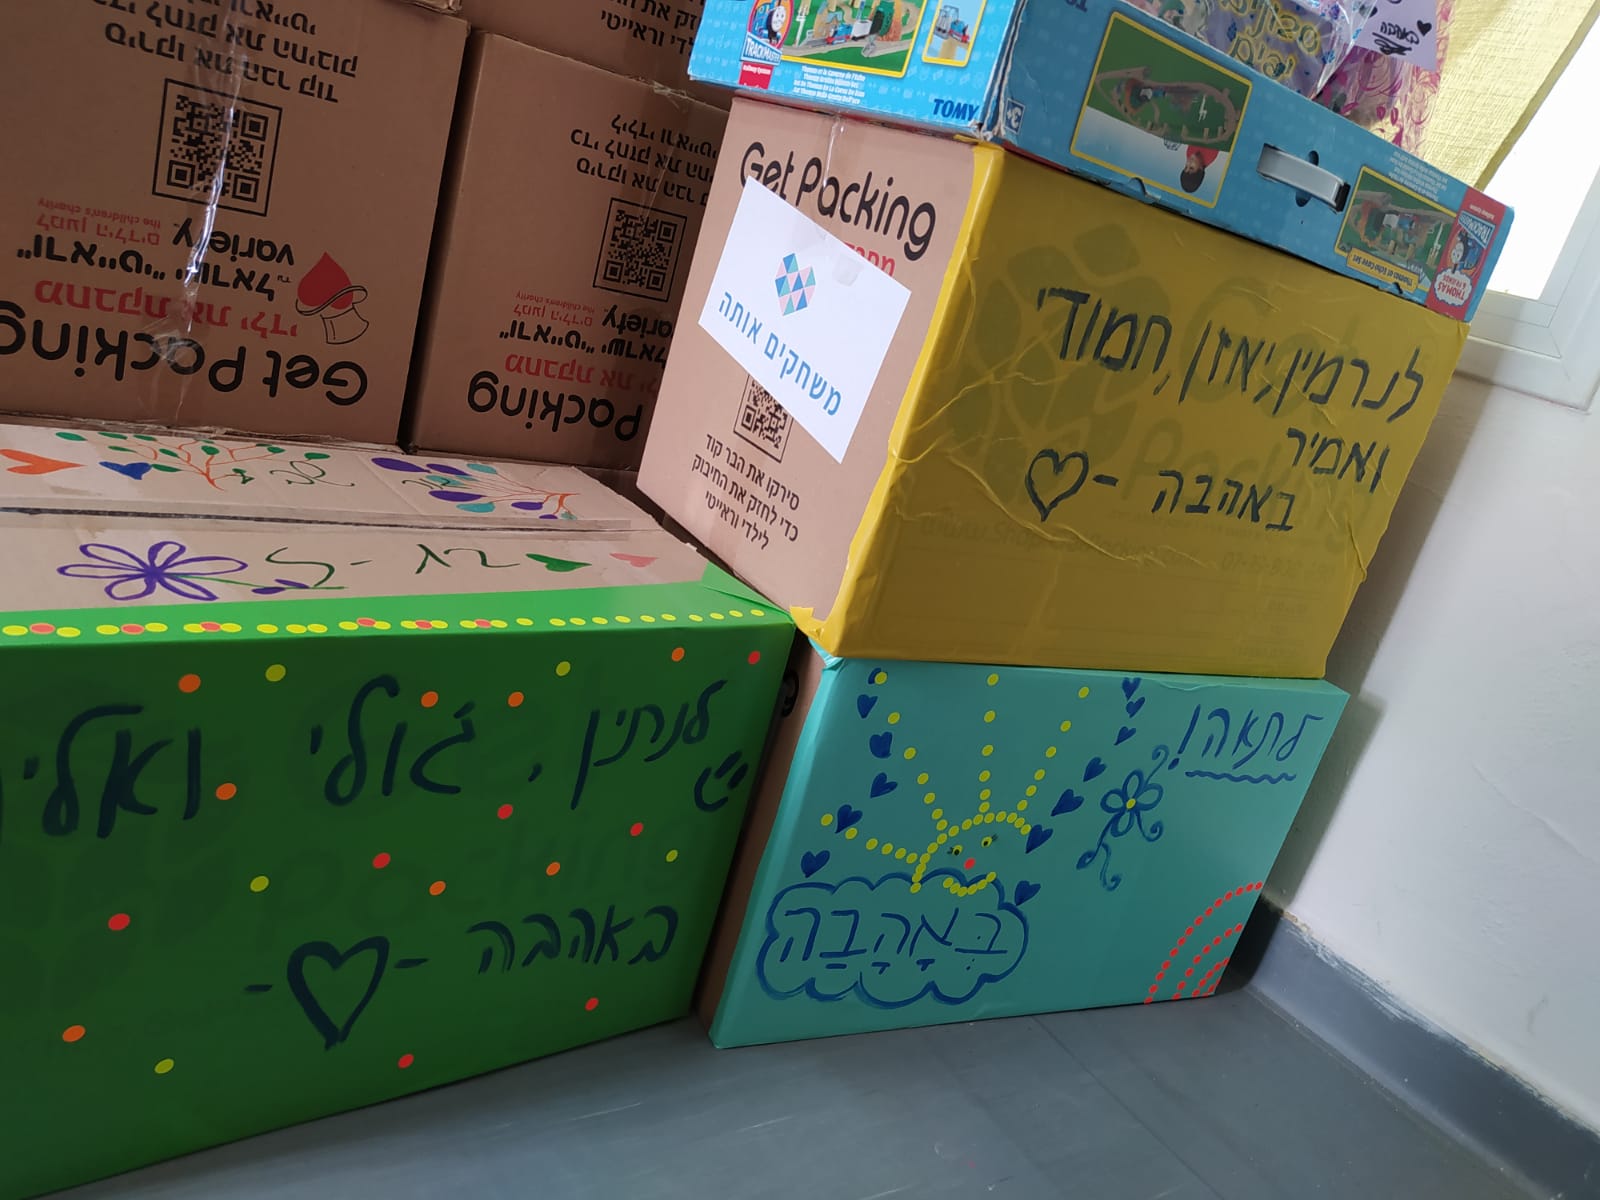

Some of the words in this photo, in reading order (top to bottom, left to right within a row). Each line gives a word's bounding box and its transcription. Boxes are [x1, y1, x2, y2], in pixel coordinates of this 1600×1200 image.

[600, 10, 665, 47] וראייטי
[104, 21, 185, 63] סירקו
[299, 74, 339, 103] קוד
[272, 39, 359, 79] החיבוק
[610, 114, 655, 141] לילדי
[932, 98, 980, 121] TOMY
[570, 128, 599, 151] כדי
[604, 139, 651, 165] לחזק
[655, 153, 682, 172] את
[575, 157, 627, 185] סירקו
[631, 174, 660, 195] את
[663, 181, 695, 204] הבר
[740, 141, 795, 201] Get
[796, 156, 937, 262] Packing
[36, 213, 88, 234] למען
[98, 221, 161, 246] הילדים
[172, 217, 296, 266] variey
[34, 279, 172, 320] מחבקת
[241, 310, 298, 339] ילדי
[1437, 280, 1467, 301] THOMAS
[513, 303, 545, 321] למען
[550, 311, 593, 327] הילדים
[602, 304, 673, 336] ariety
[718, 290, 762, 345] אותה
[263, 349, 368, 406] Get
[505, 354, 595, 385] מחבקת
[764, 332, 841, 417] משחקים
[467, 370, 643, 442] Packing
[706, 433, 724, 458] קוד
[726, 447, 746, 474] הבר
[1286, 426, 1391, 494] ואמיר
[691, 453, 729, 491] החיבוק
[746, 463, 766, 487] את
[705, 490, 740, 529] וראייטי
[728, 481, 747, 505] את
[746, 494, 778, 526] לחזק
[766, 477, 800, 511] סירקו
[1152, 469, 1296, 532] באהבה
[741, 518, 769, 550] לילדי
[779, 517, 799, 542] כדי
[0, 704, 202, 840] ואלי
[466, 904, 679, 975] באהבה
